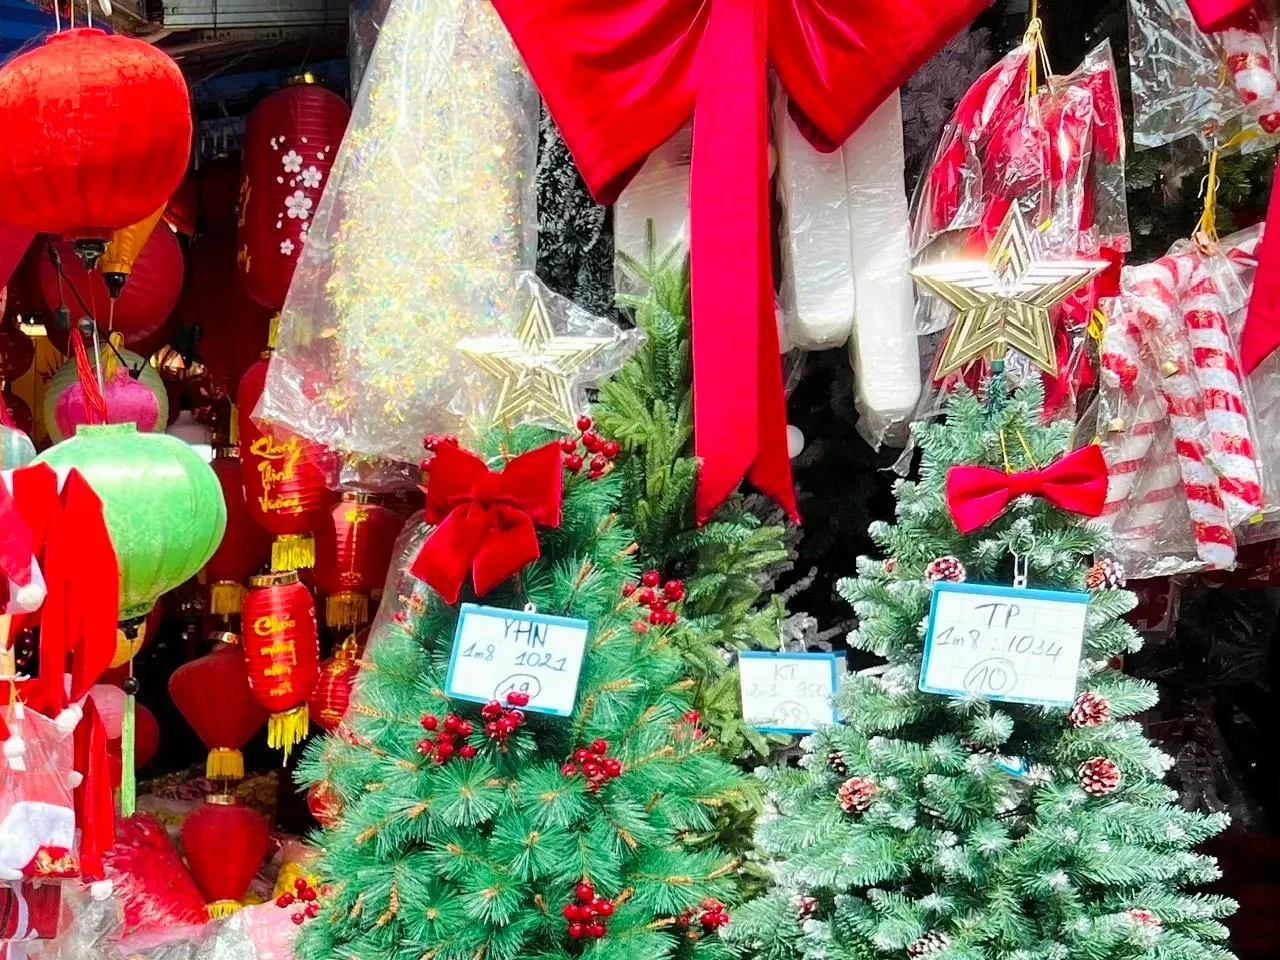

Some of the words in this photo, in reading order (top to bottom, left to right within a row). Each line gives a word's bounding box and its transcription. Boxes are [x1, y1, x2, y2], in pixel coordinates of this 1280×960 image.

[975, 602, 1020, 629] TP
[462, 642, 496, 661] 1m8
[514, 651, 567, 672] 1021
[936, 626, 981, 650] 1m8
[1008, 635, 1064, 662] 1034
[969, 666, 1008, 691] 10
